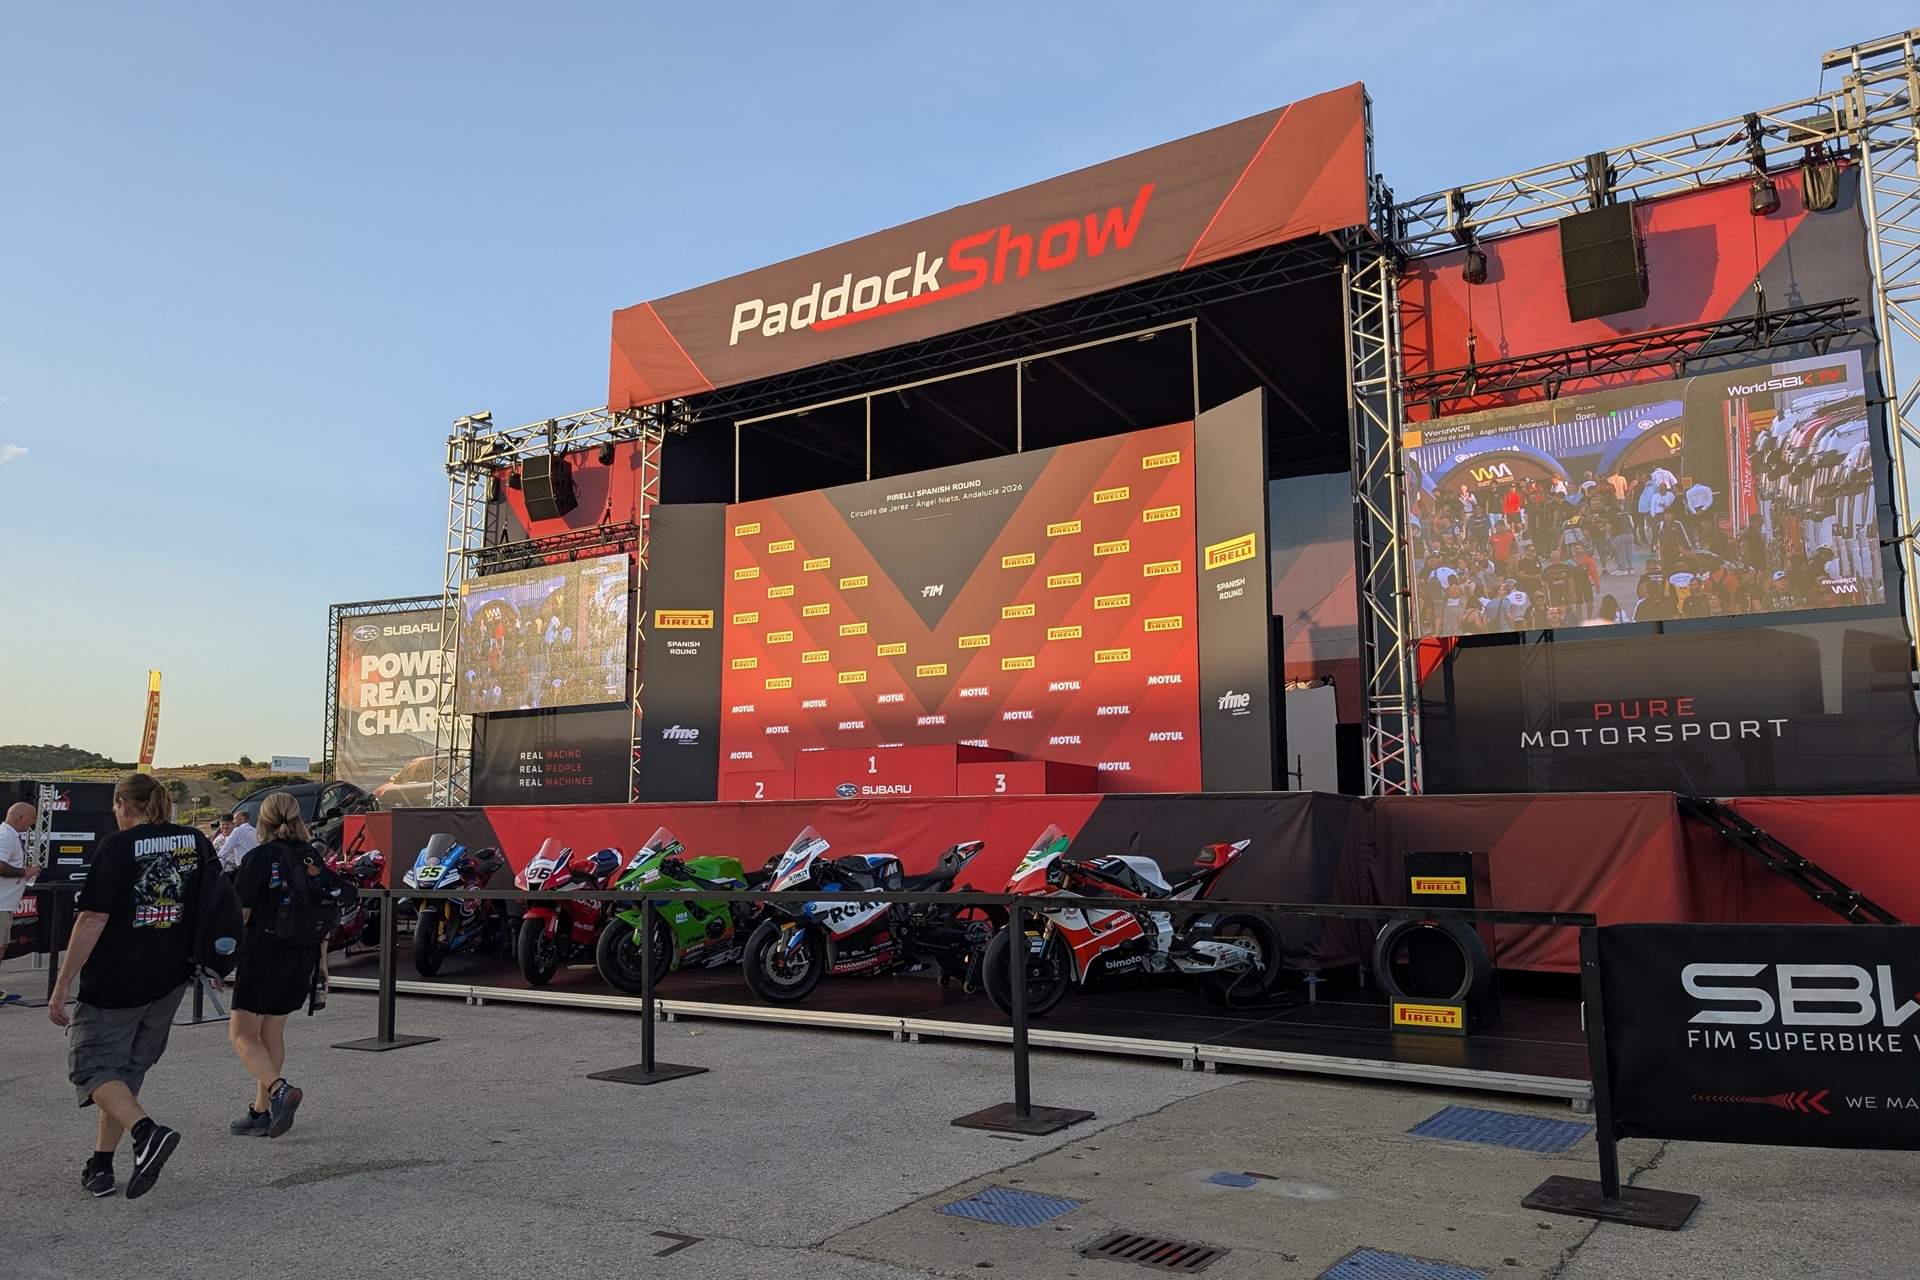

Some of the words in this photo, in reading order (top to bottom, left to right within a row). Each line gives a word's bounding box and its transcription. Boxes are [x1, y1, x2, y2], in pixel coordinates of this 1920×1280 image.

[1818, 369, 1840, 383] TV
[1575, 412, 1596, 422] Open
[1424, 424, 1471, 437] WorldWCR
[1424, 435, 1448, 445] Circuito
[1448, 433, 1457, 441] de
[1457, 431, 1474, 440] Jerez
[1479, 426, 1498, 438] Ángel
[1518, 419, 1550, 430] Andalucía
[1145, 454, 1178, 467] PIRELLI
[886, 491, 915, 502] PIRELLI
[916, 485, 951, 497] SPANISH
[952, 479, 981, 491] ROUND
[1096, 489, 1127, 502] PIRELLI
[850, 508, 877, 518] Circuito
[878, 506, 888, 514] de
[889, 503, 909, 513] Jerez
[915, 495, 937, 508] Ángel
[938, 495, 961, 504] Nieto,
[962, 487, 999, 500] Andalucía
[1001, 483, 1023, 494] 2026
[1145, 508, 1178, 521] PIRELLI
[737, 525, 759, 534] PIRELLI
[1049, 523, 1079, 535] PIRELLI
[770, 542, 793, 552] PIRELLI
[1096, 542, 1127, 554] PIRELLI
[1208, 539, 1252, 566] PIRELLI
[805, 560, 829, 569] PIRELLI
[1004, 555, 1033, 566] PIRELLI
[736, 569, 758, 578] PIRELLI
[1146, 563, 1179, 575] PIRELLI
[842, 578, 866, 588] PIRELLI
[1049, 575, 1079, 586] PIRELLI
[1216, 577, 1245, 592] SPANISH
[770, 587, 792, 597] PIRELLI
[924, 584, 944, 597] FIM
[1219, 588, 1243, 601] ROUND
[1097, 596, 1128, 607] PIRELLI
[805, 606, 828, 615] PIRELLI
[1004, 607, 1033, 617] PIRELLI
[659, 613, 710, 626] PIRELLI
[735, 614, 757, 622] PIRELLI
[383, 622, 440, 637] SUBARU
[841, 625, 865, 634] PIRELLI
[1147, 618, 1180, 630] PIRELLI
[769, 633, 791, 642] PIRELLI
[1050, 628, 1080, 639] PIRELLI
[961, 637, 988, 647] PIRELLI
[879, 645, 905, 654] PIRELLI
[804, 652, 827, 662] PIRELLI
[1097, 651, 1129, 661] PIRELLI
[734, 659, 756, 668] PIRELLI
[1004, 658, 1033, 668] PIRELLI
[919, 666, 945, 675] PIRELLI
[767, 679, 790, 687] PIRELLI
[840, 673, 864, 682] PIRELLI
[1147, 674, 1183, 685] MOTUL
[1048, 680, 1081, 692] MOTUL
[959, 687, 989, 698] MOTUL
[801, 699, 828, 709] MOTUL
[877, 693, 905, 704] MOTUL
[731, 704, 755, 714] MOTUL
[1096, 705, 1131, 716] MOTUL
[1594, 698, 1696, 721] PURE
[917, 715, 946, 726] MOTUL
[1002, 710, 1034, 721] MOTUL
[140, 691, 160, 765] PIRELLI
[765, 725, 790, 735] MOTUL
[838, 720, 865, 730] MOTUL
[1148, 731, 1184, 742] MOTUL
[1520, 718, 1789, 748] MOTORSPORT
[1049, 735, 1082, 746] MOTUL
[520, 751, 544, 760] REAL
[546, 750, 581, 759] RACING
[729, 751, 754, 760] MOTUL
[519, 765, 543, 773] REAL
[546, 763, 583, 773] PEOPLE
[868, 756, 877, 774] 1
[1097, 761, 1132, 771] MOTUL
[519, 778, 542, 787] REAL
[545, 777, 594, 786] MACHINES
[994, 774, 1007, 793] 3
[755, 782, 764, 798] 2
[862, 784, 912, 795] SUBARU
[134, 834, 196, 857] DONINGTON
[172, 847, 198, 858] PARK
[1099, 859, 1121, 870] bimota
[419, 866, 443, 879] 55
[528, 867, 553, 880] 96
[555, 873, 572, 883] MOTUL
[1416, 880, 1461, 891] PIRELLI
[1111, 913, 1132, 927] MOTUL
[686, 942, 705, 953] MOTUL
[834, 956, 878, 971] CHAMPION
[1105, 954, 1142, 969] bimota
[1400, 1008, 1456, 1024] PIRELLI
[1688, 1030, 1736, 1049] FIM
[1749, 1032, 1903, 1053] SUPERBIKE
[1845, 1096, 1878, 1109] WE
